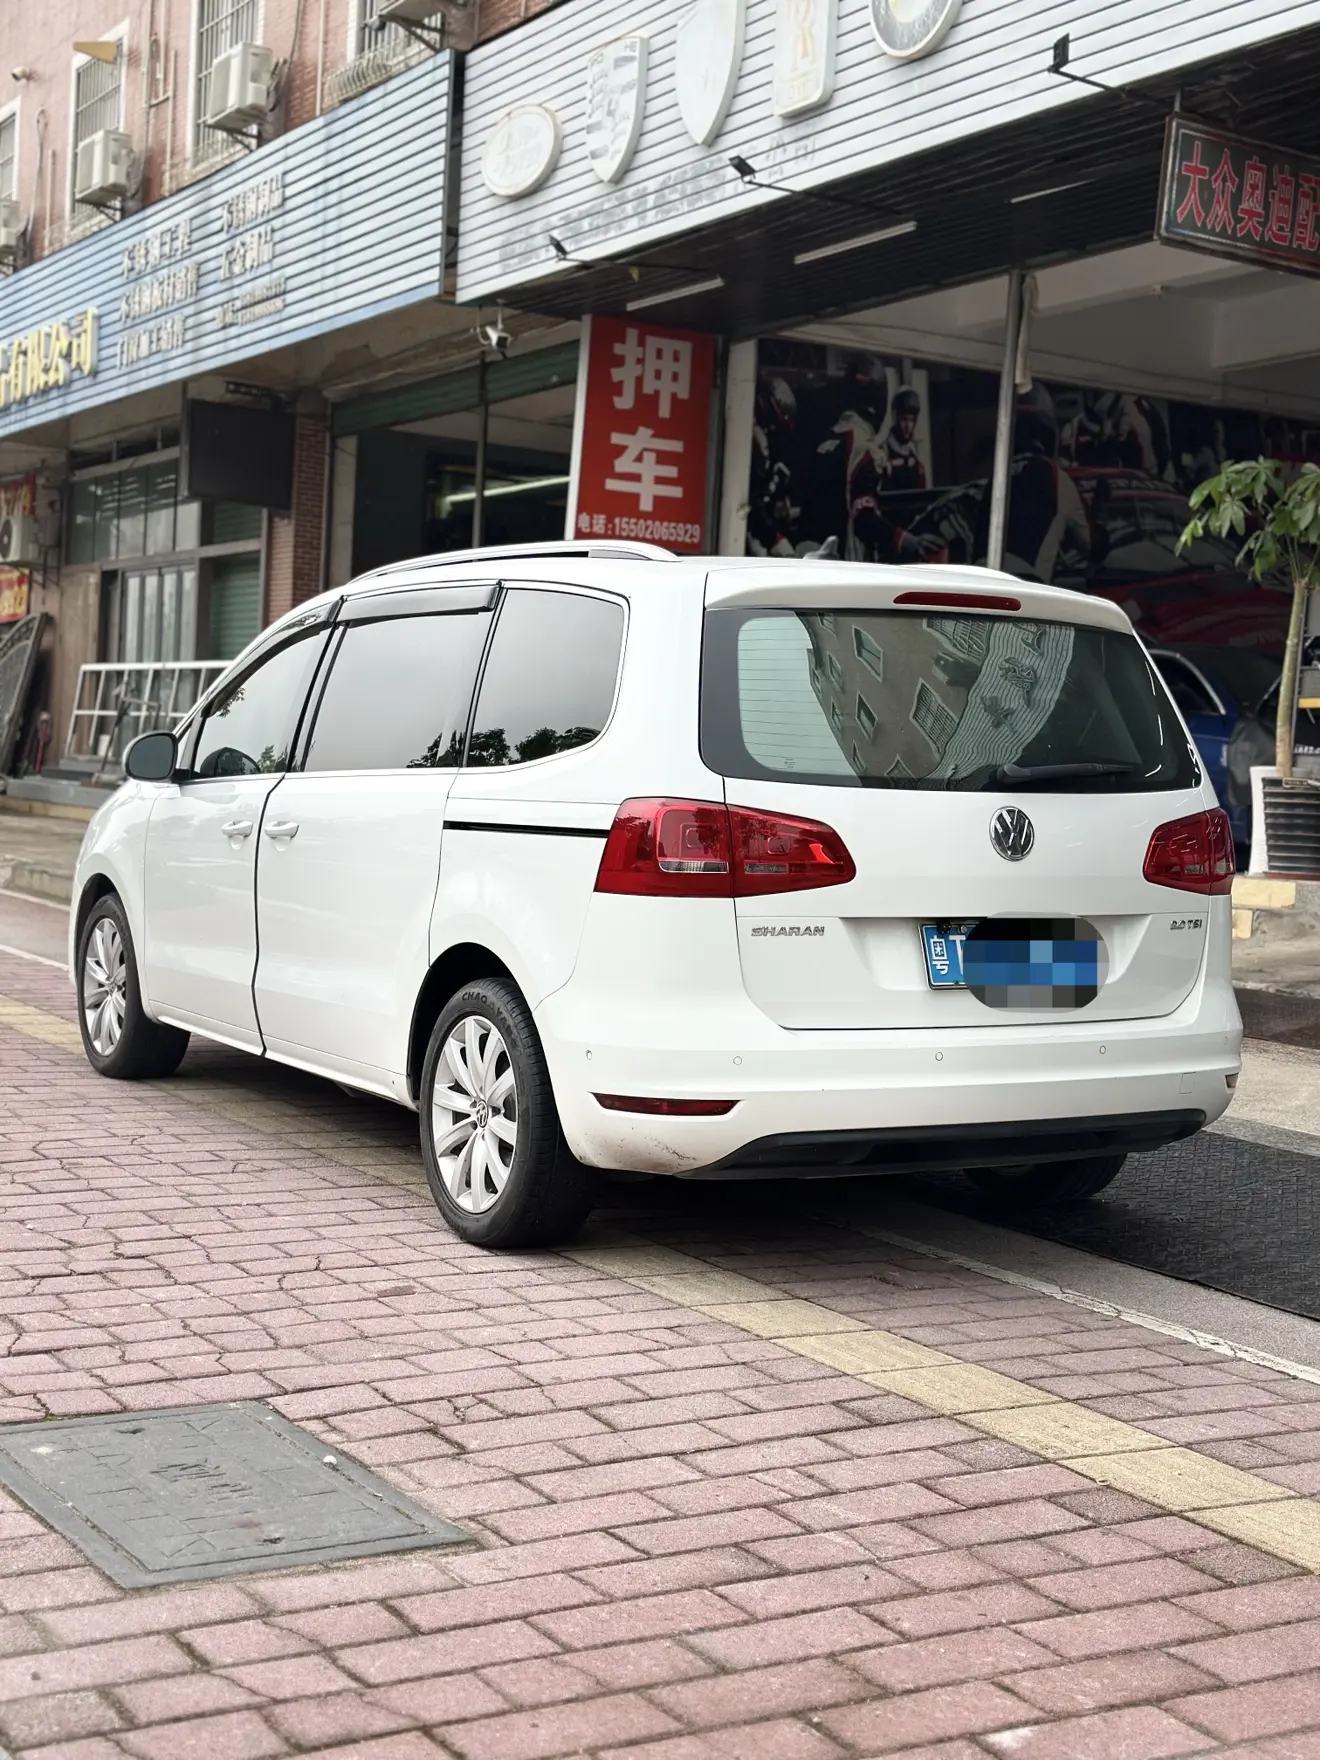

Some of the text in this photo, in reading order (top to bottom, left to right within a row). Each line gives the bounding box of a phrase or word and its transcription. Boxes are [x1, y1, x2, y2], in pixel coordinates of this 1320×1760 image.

[1177, 141, 1320, 251] 大众奥迪配
[604, 327, 693, 512] 押车
[751, 925, 825, 937] SHARAN
[462, 992, 487, 1003] CHAO
